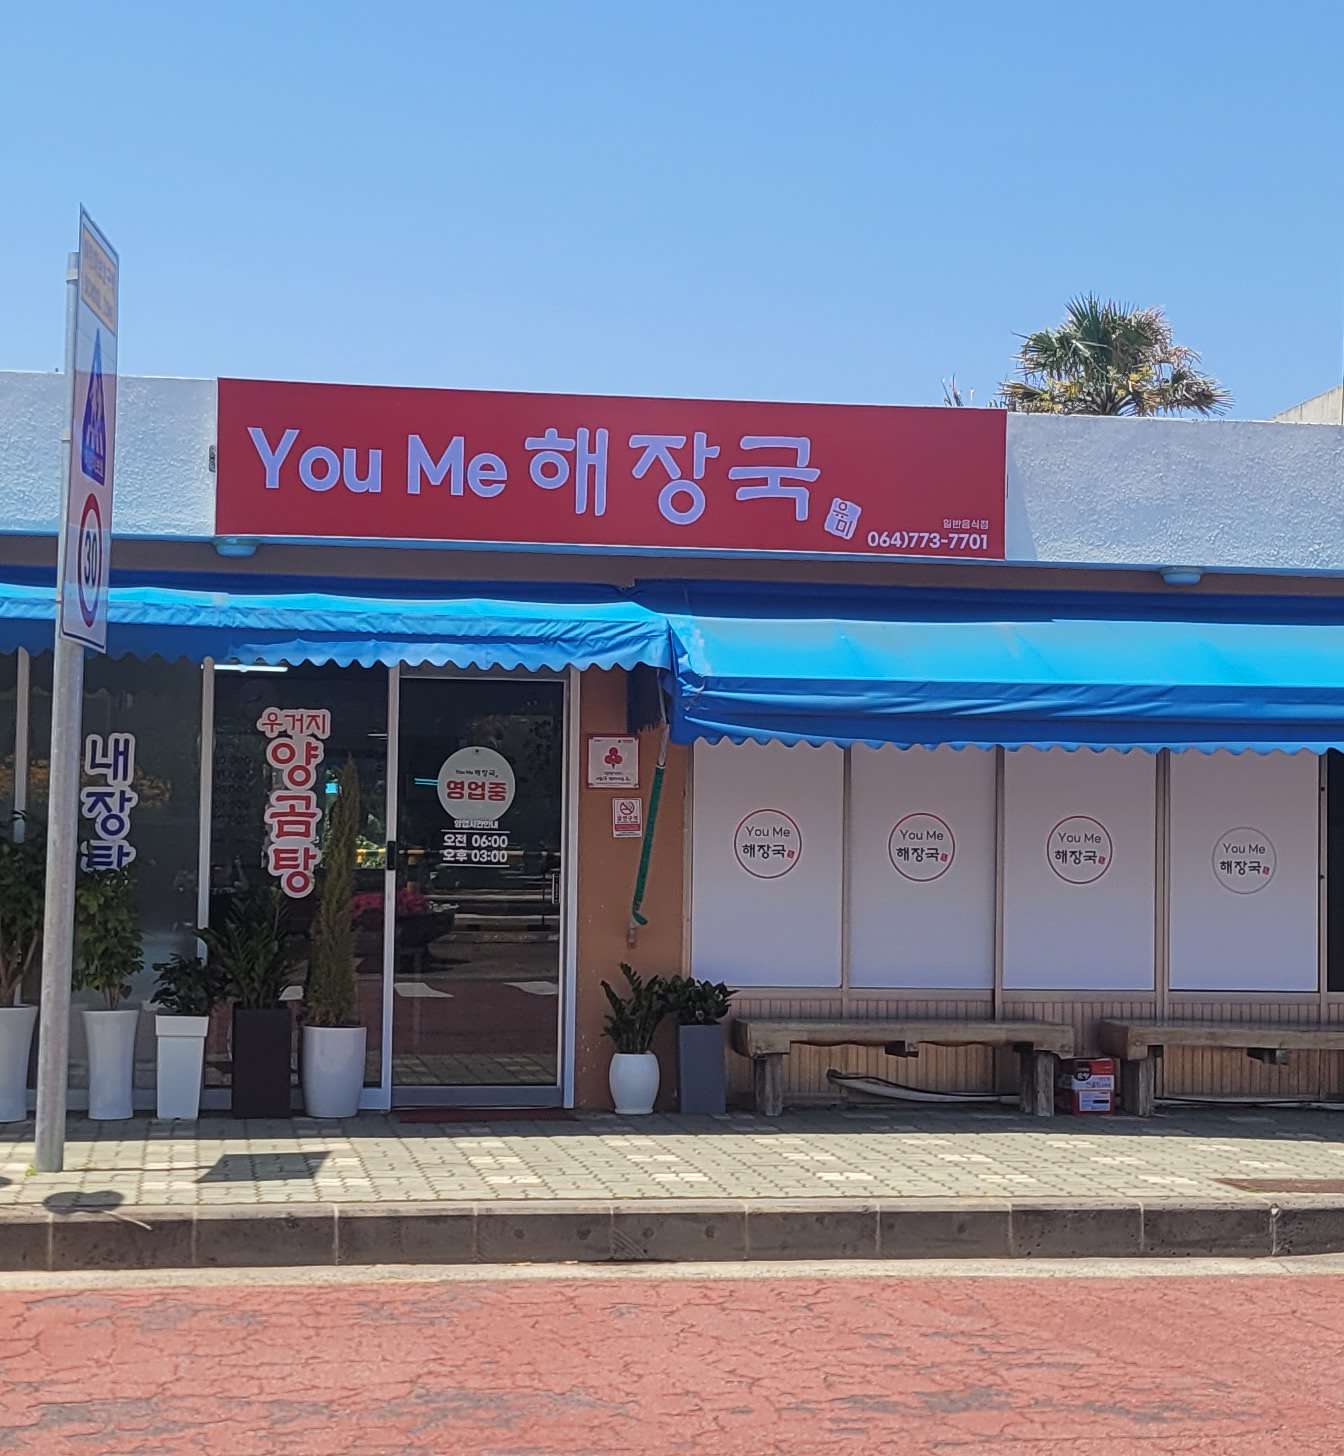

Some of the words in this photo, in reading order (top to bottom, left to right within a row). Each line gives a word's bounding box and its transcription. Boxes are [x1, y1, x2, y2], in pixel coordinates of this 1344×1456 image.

[246, 426, 382, 493] You
[406, 433, 508, 497] Me
[523, 427, 822, 525] 해장국
[942, 518, 989, 530] 일반음식점
[867, 531, 988, 550] 064)773-7701
[83, 530, 98, 588] 30
[261, 711, 327, 735] 우거지
[446, 780, 507, 802] 영업중
[268, 740, 320, 894] 양곰탕
[745, 826, 769, 837] You
[772, 826, 791, 837] Me
[899, 829, 923, 841] You
[926, 830, 944, 841] Me
[1057, 832, 1081, 843] You
[1084, 832, 1102, 844] Me
[443, 834, 468, 847] 오전
[471, 835, 509, 848] 06:00
[1222, 843, 1246, 854] You
[1248, 844, 1266, 855] Me
[442, 849, 468, 862] 오후
[471, 850, 508, 863] 03:00
[741, 843, 787, 859] 해장국
[895, 846, 940, 862] 해장국
[1054, 849, 1098, 865] 해장국
[1219, 860, 1263, 875] 해장국
